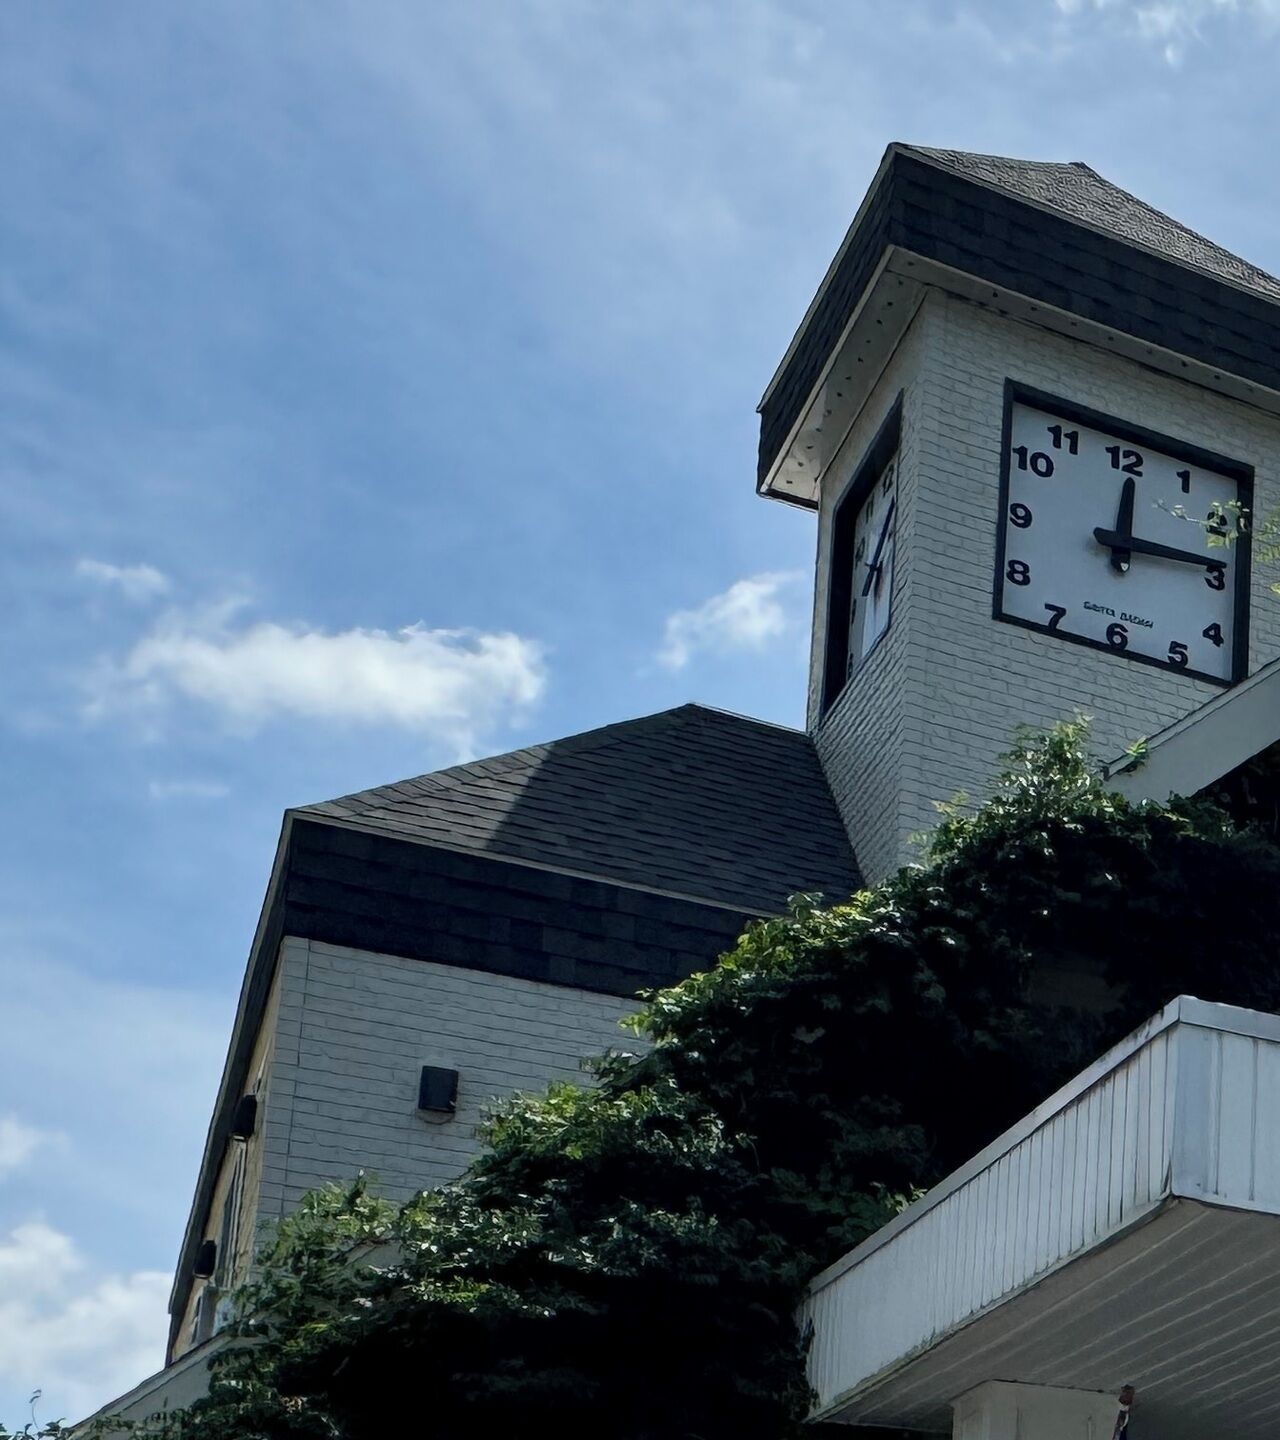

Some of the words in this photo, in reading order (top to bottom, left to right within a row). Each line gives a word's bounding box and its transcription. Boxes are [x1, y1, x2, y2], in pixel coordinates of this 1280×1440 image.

[1047, 425, 1079, 455] 11
[1012, 445, 1054, 478] 10
[1105, 446, 1144, 478] 12
[1176, 470, 1191, 494] 1
[1009, 502, 1033, 529] 9
[1006, 559, 1031, 586] 8
[1204, 563, 1226, 591] 3
[1044, 602, 1067, 631] 7
[1106, 622, 1129, 651] 6
[1202, 622, 1225, 648] 4
[1167, 640, 1189, 669] 5
